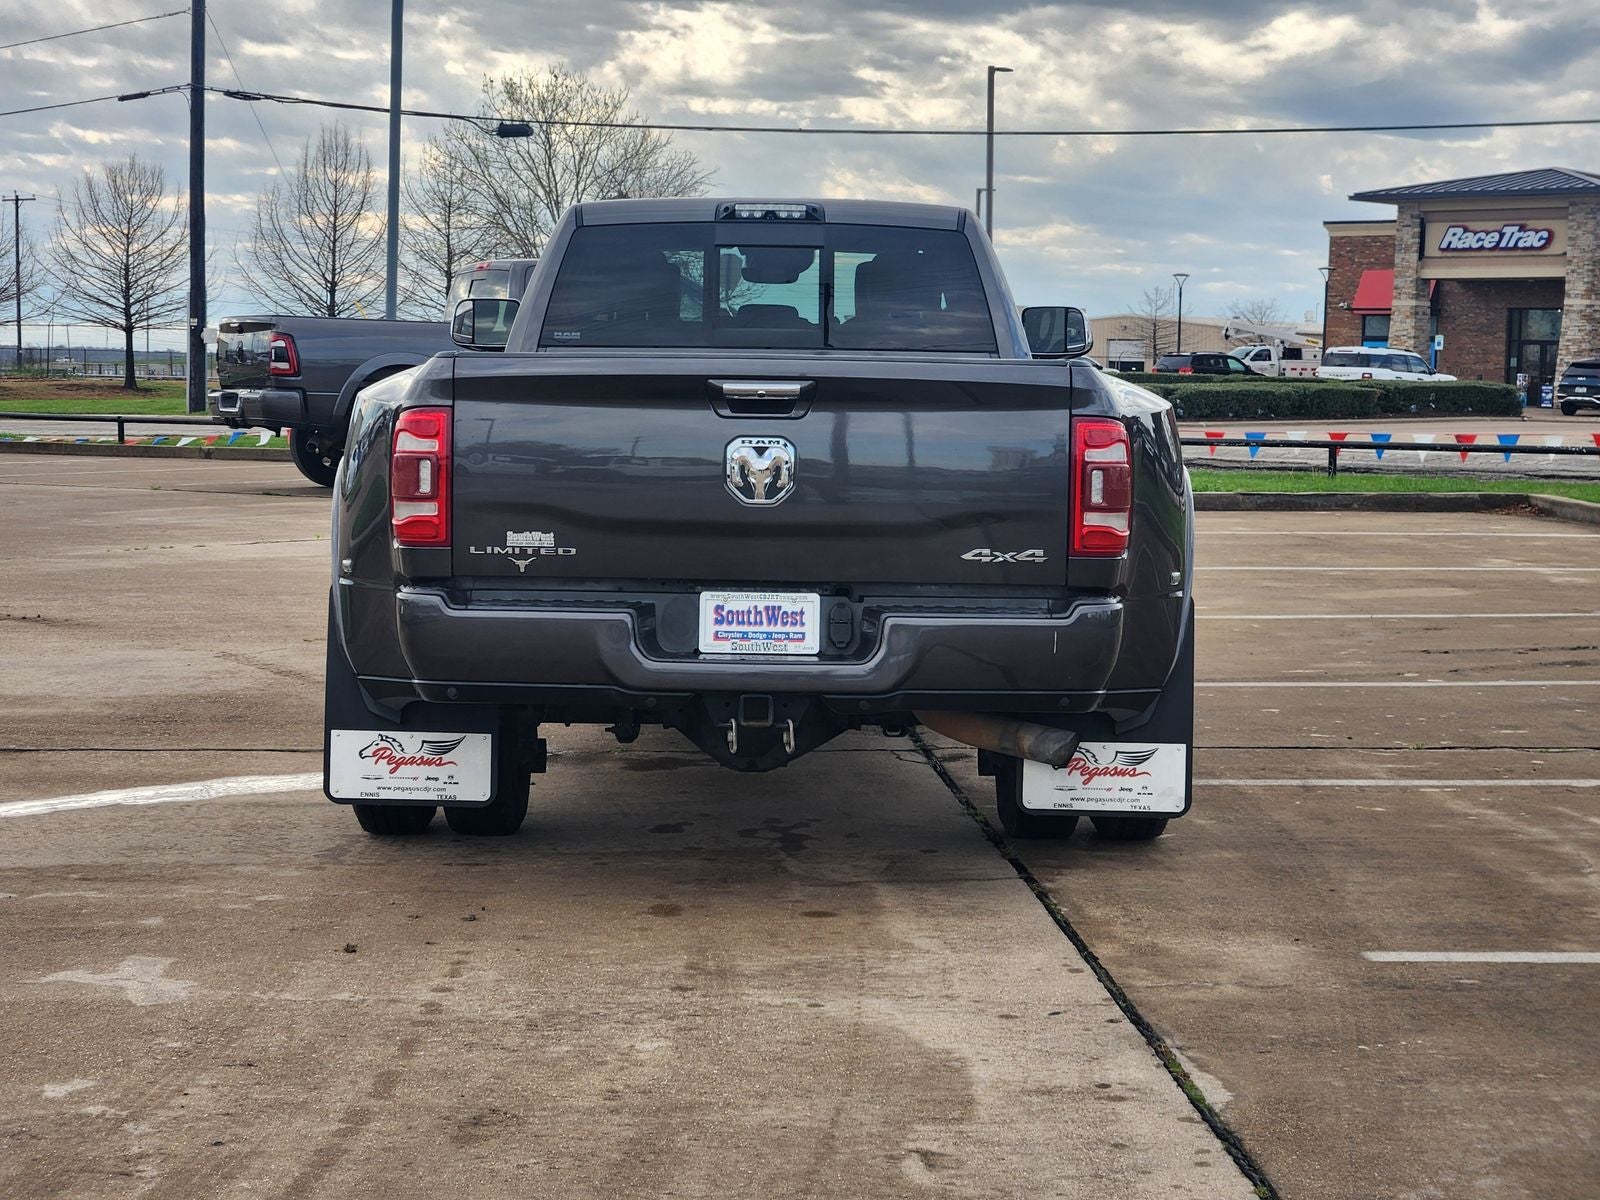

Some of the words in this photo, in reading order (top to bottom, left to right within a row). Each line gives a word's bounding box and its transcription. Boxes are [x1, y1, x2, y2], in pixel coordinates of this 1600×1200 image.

[1439, 225, 1551, 250] RaceTrac
[469, 546, 577, 555] LIMITED
[713, 603, 806, 628] SouthWest
[718, 631, 743, 640] Chrysler
[748, 632, 767, 640] Dodge
[772, 632, 786, 640] Jeep
[731, 642, 789, 652] SouthWest
[371, 746, 458, 775] Pegasus
[1067, 757, 1152, 785] Pegasus
[376, 785, 447, 793] www.pegasuscdjr.com
